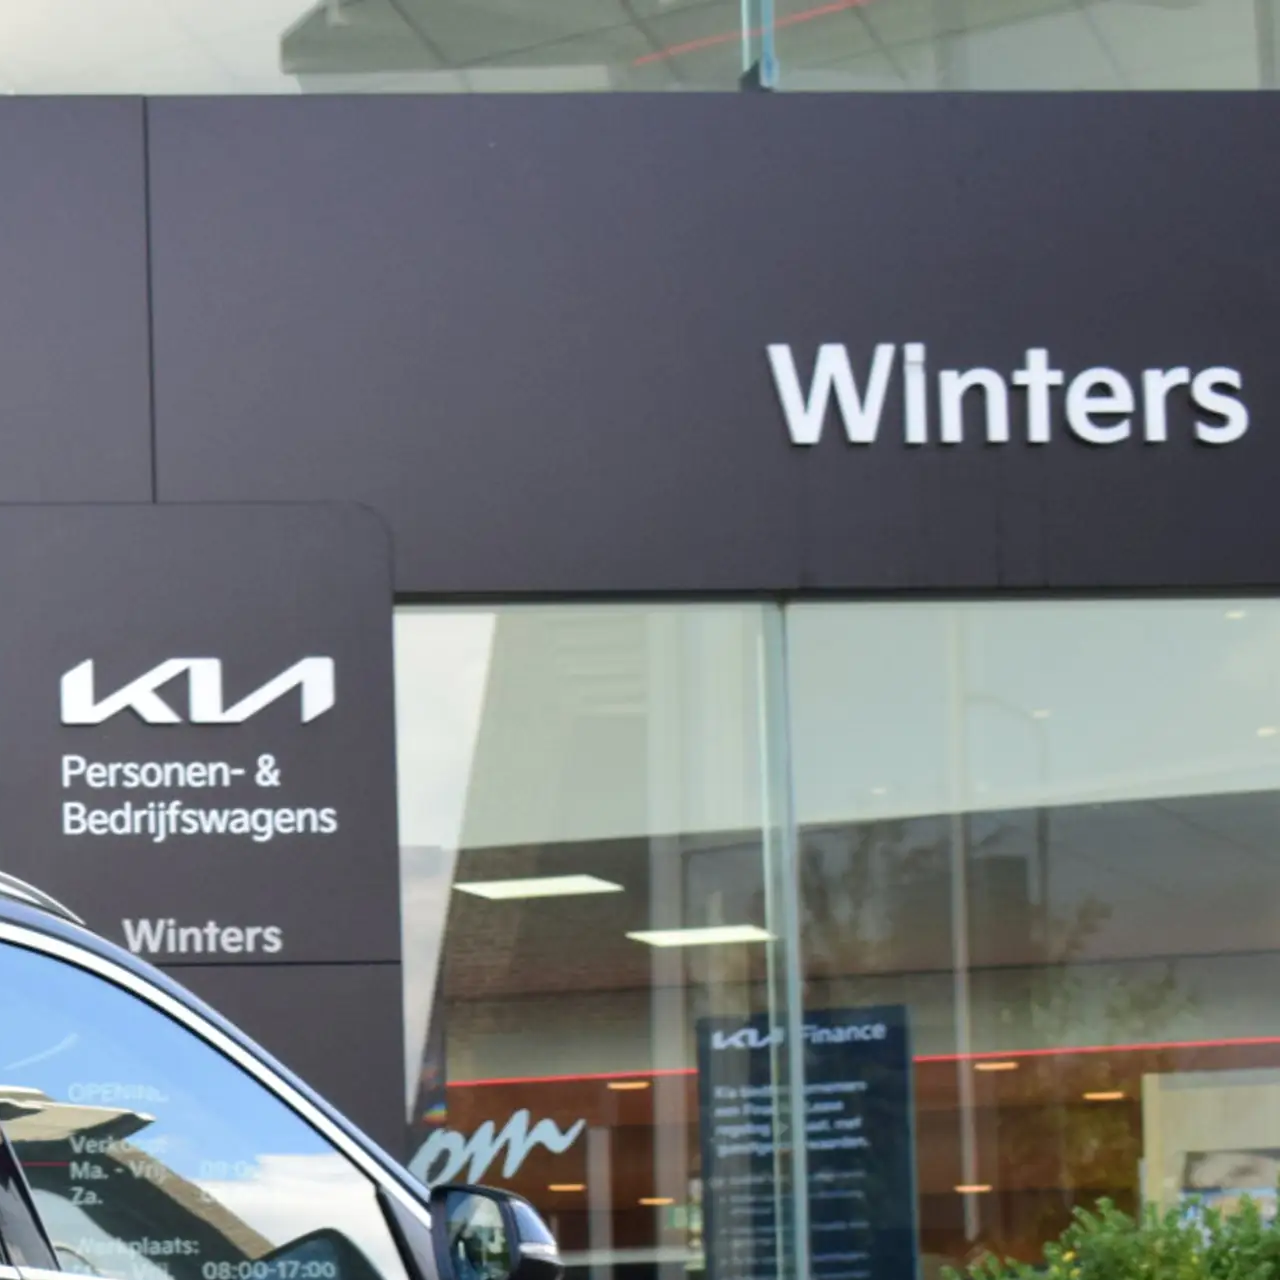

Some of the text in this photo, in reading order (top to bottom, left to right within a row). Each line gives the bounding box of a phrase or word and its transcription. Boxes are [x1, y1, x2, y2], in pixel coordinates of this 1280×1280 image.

[766, 342, 1250, 446] Winters
[60, 656, 336, 725] KIA
[61, 753, 281, 789] Personen- &
[62, 800, 338, 842] Bedrijfswagens
[121, 917, 283, 954] Winters
[69, 1161, 109, 1181] Ma.
[201, 1260, 337, 1280] 08:00-17:00
